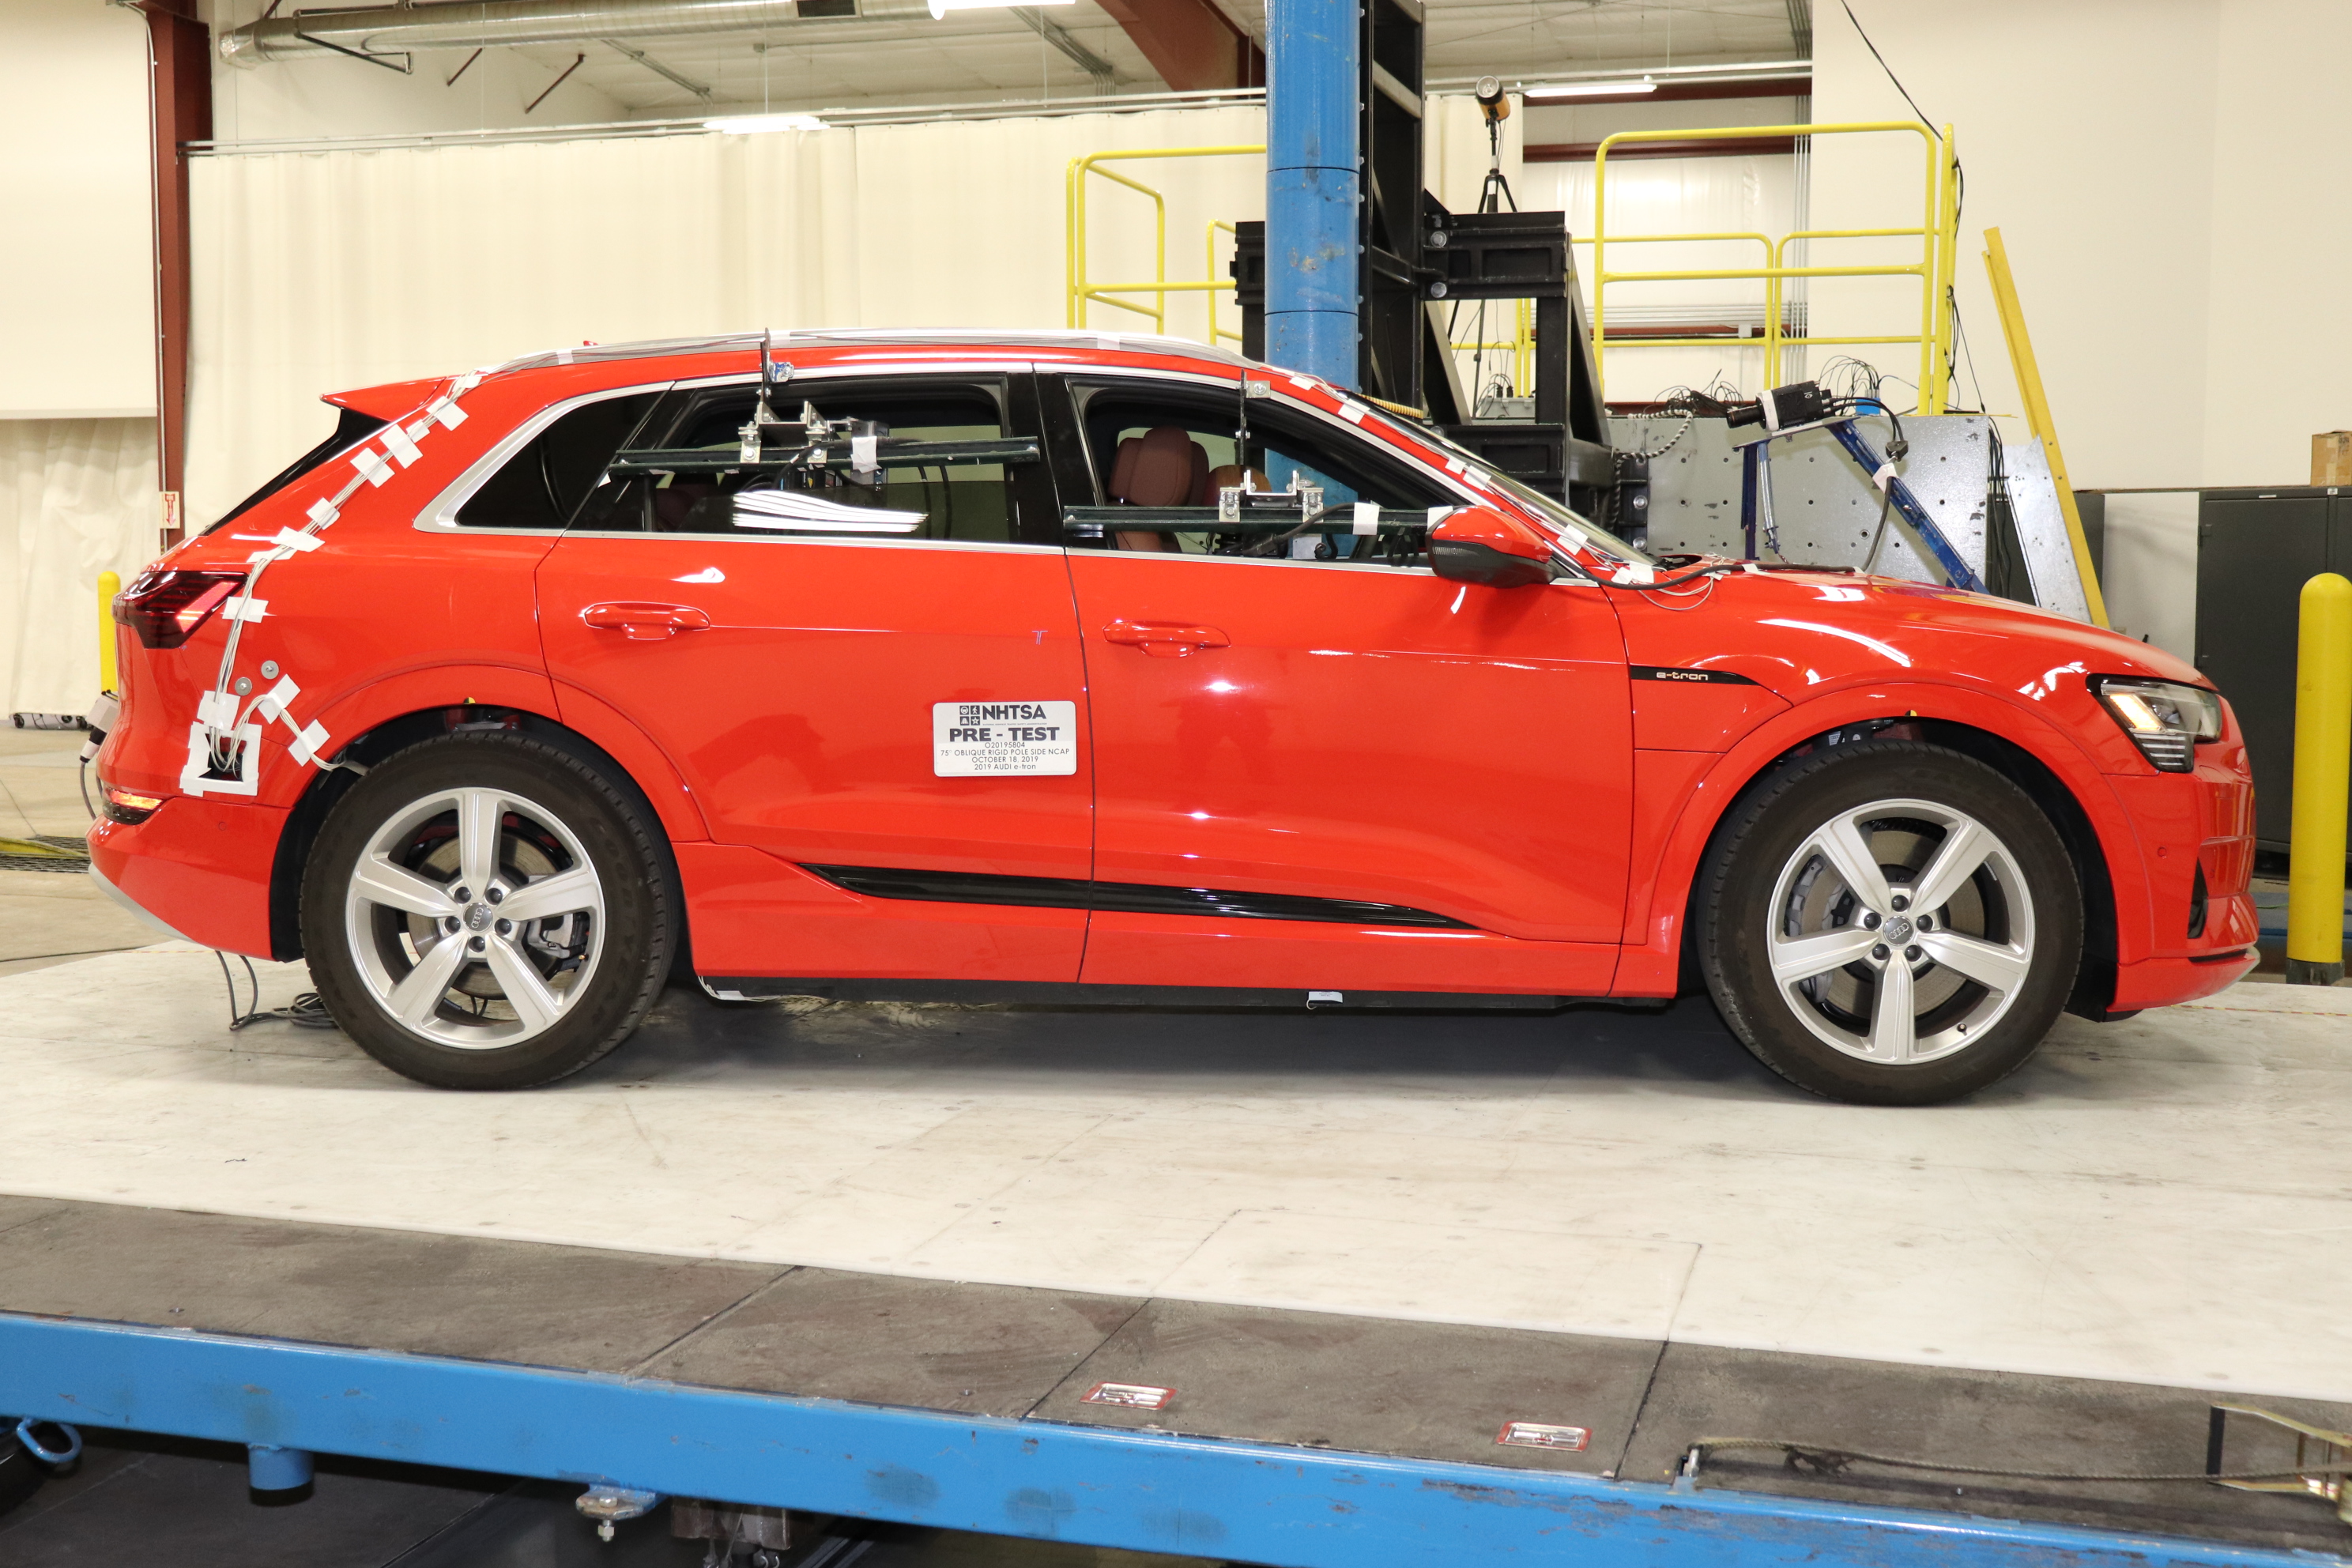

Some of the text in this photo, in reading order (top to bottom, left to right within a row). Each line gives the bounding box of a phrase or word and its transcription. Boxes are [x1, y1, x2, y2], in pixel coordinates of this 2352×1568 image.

[1657, 671, 1709, 681] e-tron
[982, 704, 1047, 720] NHTSA
[949, 727, 992, 742] PRE
[1008, 726, 1060, 741] TEST
